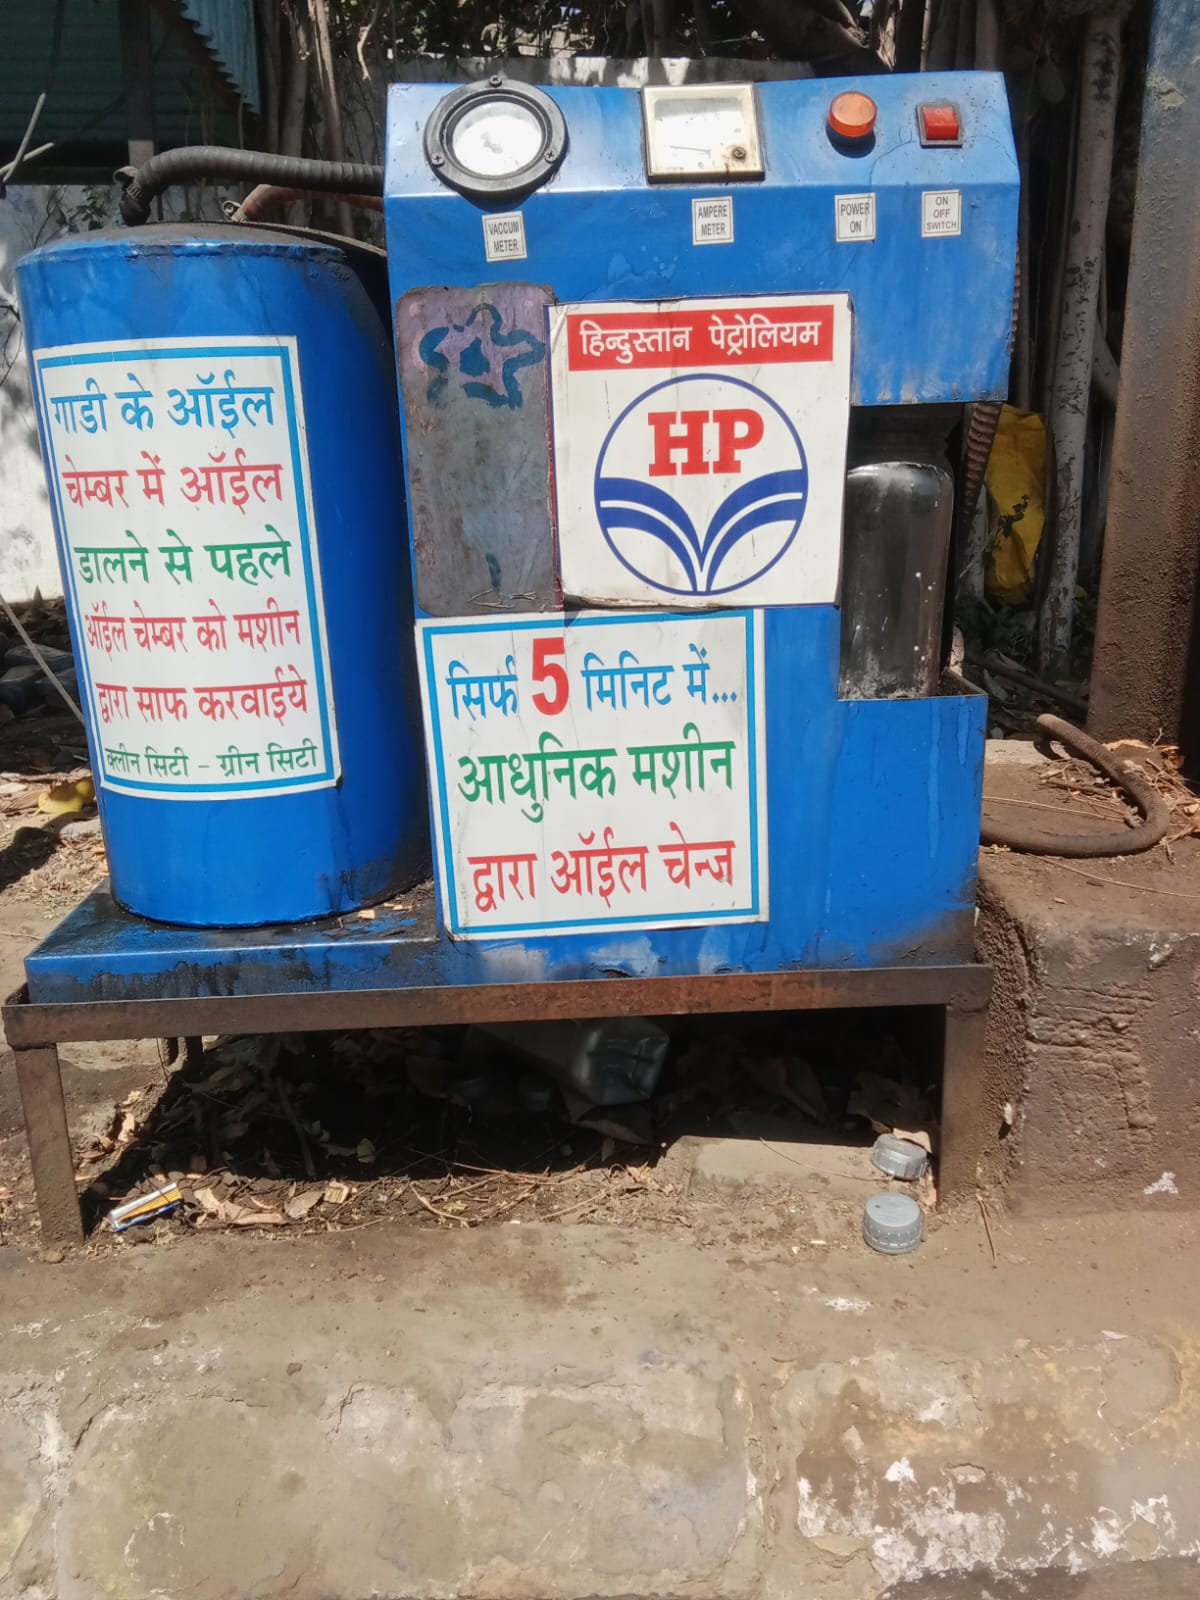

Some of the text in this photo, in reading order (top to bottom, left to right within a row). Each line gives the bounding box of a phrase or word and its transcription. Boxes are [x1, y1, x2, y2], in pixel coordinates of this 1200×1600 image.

[698, 205, 728, 219] AMPERE
[840, 202, 870, 216] POWER
[932, 208, 951, 219] OFF
[935, 196, 949, 206] ON
[488, 221, 519, 236] VACCUM
[493, 239, 518, 253] METER
[701, 222, 726, 236] METER
[849, 221, 862, 233] ON
[926, 221, 957, 231] SWITCH
[579, 315, 821, 364] हिन्दुस्तान पेट्रोलियम
[50, 370, 275, 439] गाडी के ऑईल
[647, 408, 764, 477] HP
[62, 447, 283, 514] चेम्बर में ऑईल
[73, 524, 292, 585] डालने से पहले
[84, 596, 301, 662] ऑईल चेम्बर को मशीन
[95, 664, 307, 727] द्वारा साफ करवाईये
[446, 654, 519, 721] सिर्फ
[531, 637, 569, 716] 5
[580, 650, 675, 711] मिनिट
[104, 743, 140, 776] क्लीन
[144, 747, 189, 777] सिटी
[216, 743, 260, 777] ग्रीन
[266, 738, 317, 773] सिटी
[457, 722, 736, 823] आधुनिक मशीन
[467, 821, 736, 912] द्वारा ऑईल चेन्ज
